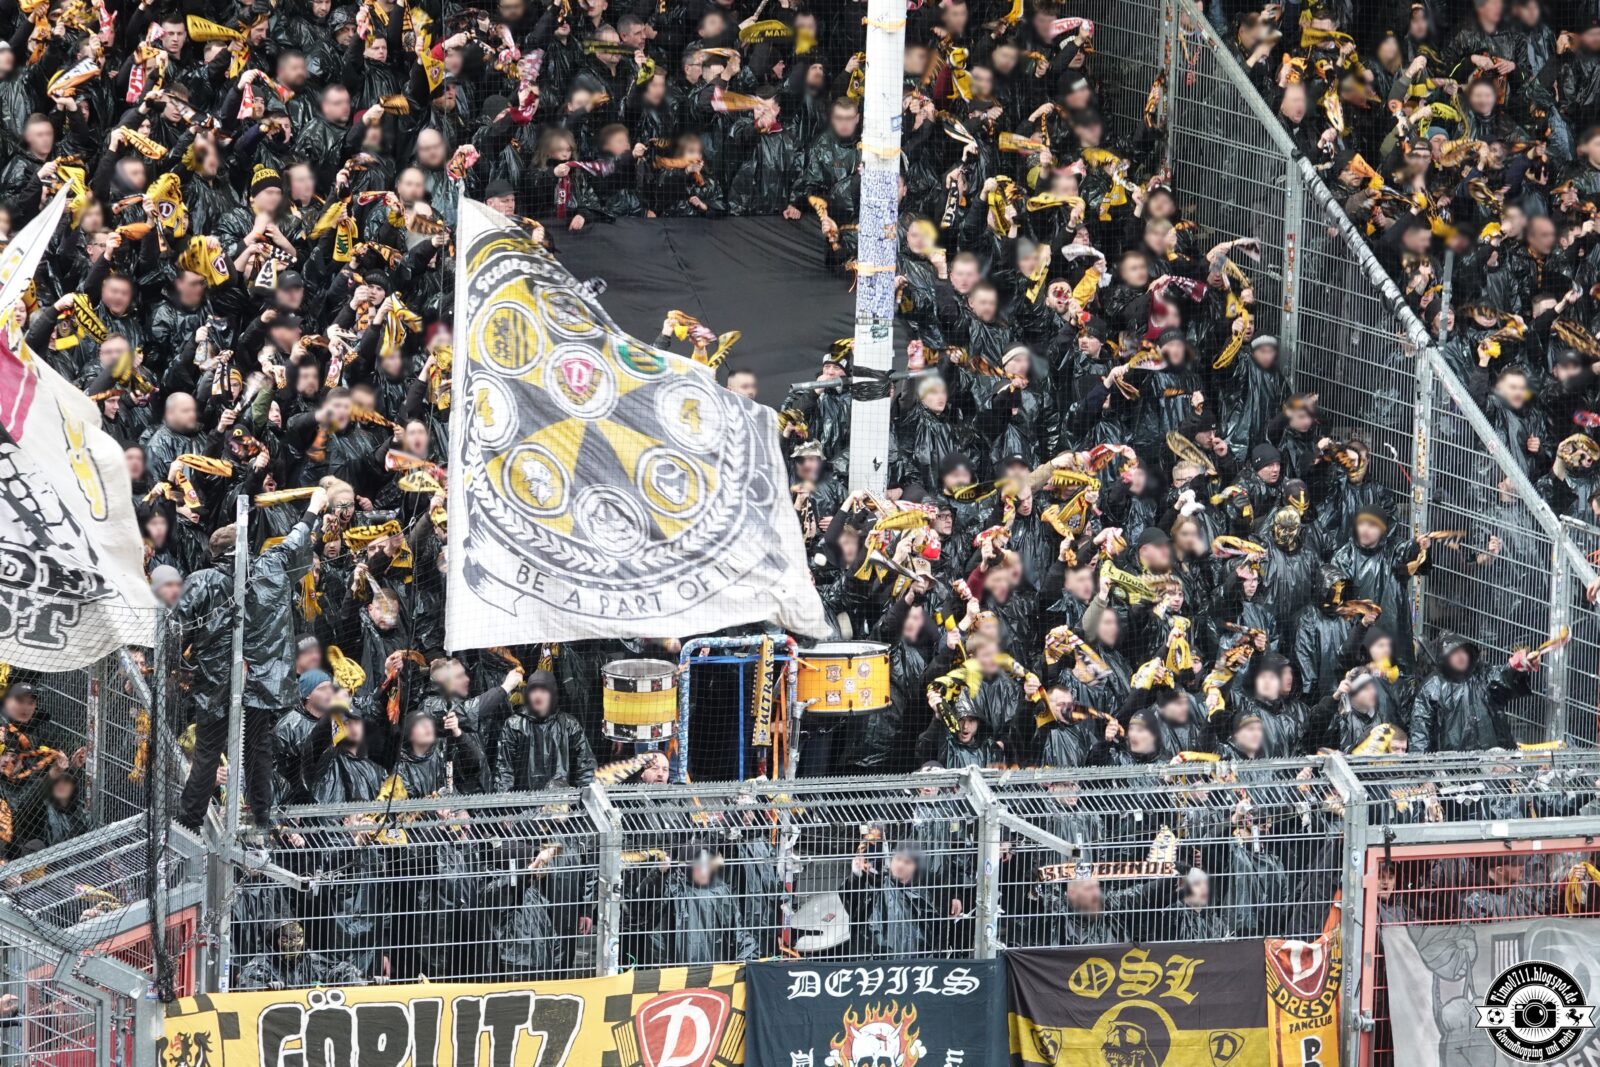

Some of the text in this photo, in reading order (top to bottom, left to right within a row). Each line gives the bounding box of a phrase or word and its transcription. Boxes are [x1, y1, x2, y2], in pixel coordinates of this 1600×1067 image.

[516, 563, 549, 593] BE
[563, 591, 582, 609] A
[600, 592, 664, 616] PART
[677, 579, 712, 601] OF
[760, 658, 775, 726] ULTRAS
[787, 965, 980, 1000] DEVILS
[1068, 948, 1204, 1005] OSL
[1275, 962, 1342, 1018] DRESDEN
[1289, 1015, 1333, 1034] FANCLUB
